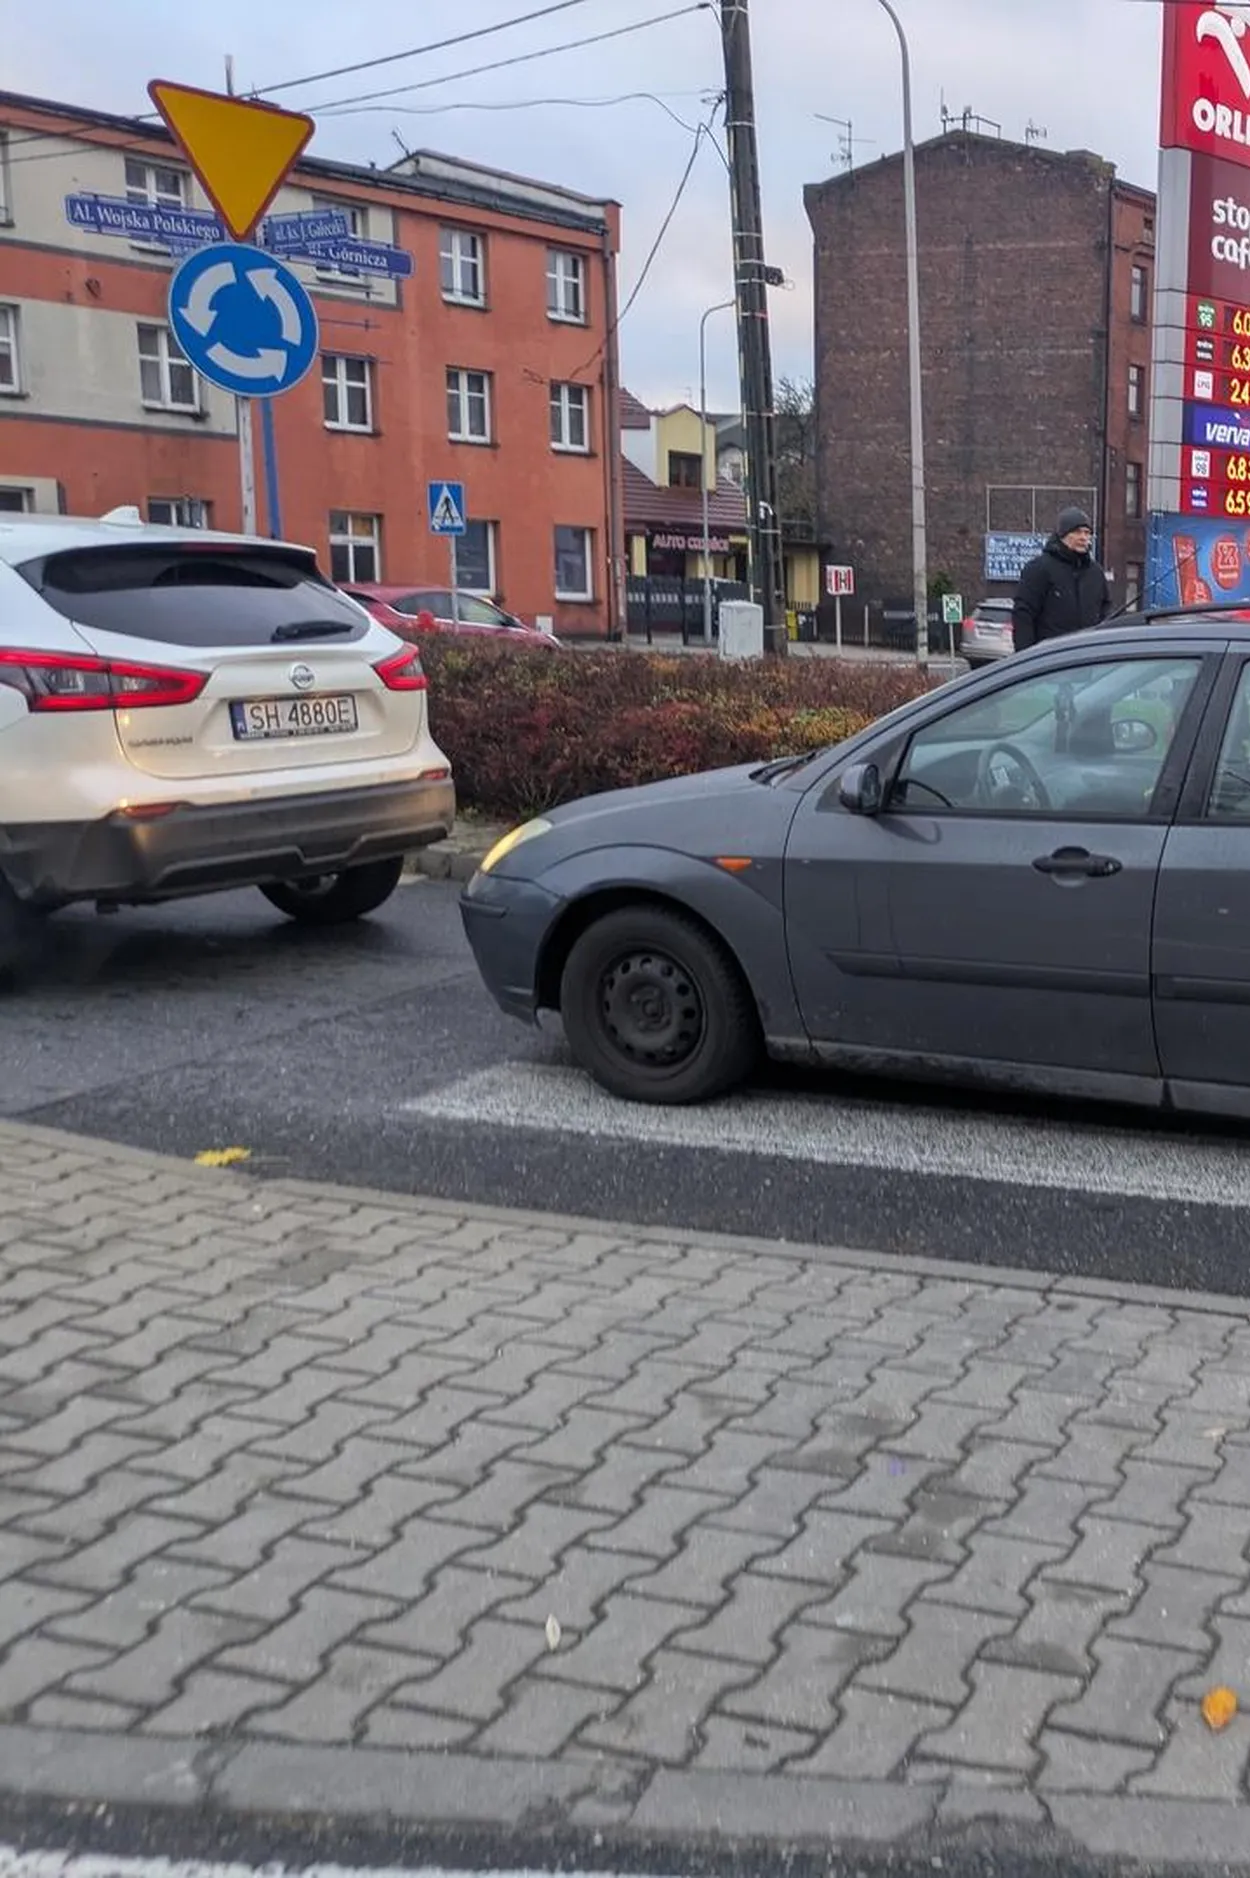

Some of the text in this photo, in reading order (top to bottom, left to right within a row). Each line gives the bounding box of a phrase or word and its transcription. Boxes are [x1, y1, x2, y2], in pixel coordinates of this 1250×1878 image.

[73, 202, 221, 241] Al. Wojska Polskiego
[329, 246, 388, 268] Górnicza
[653, 534, 686, 549] AUTO
[250, 702, 281, 731] SH
[288, 698, 351, 727] 4880E
